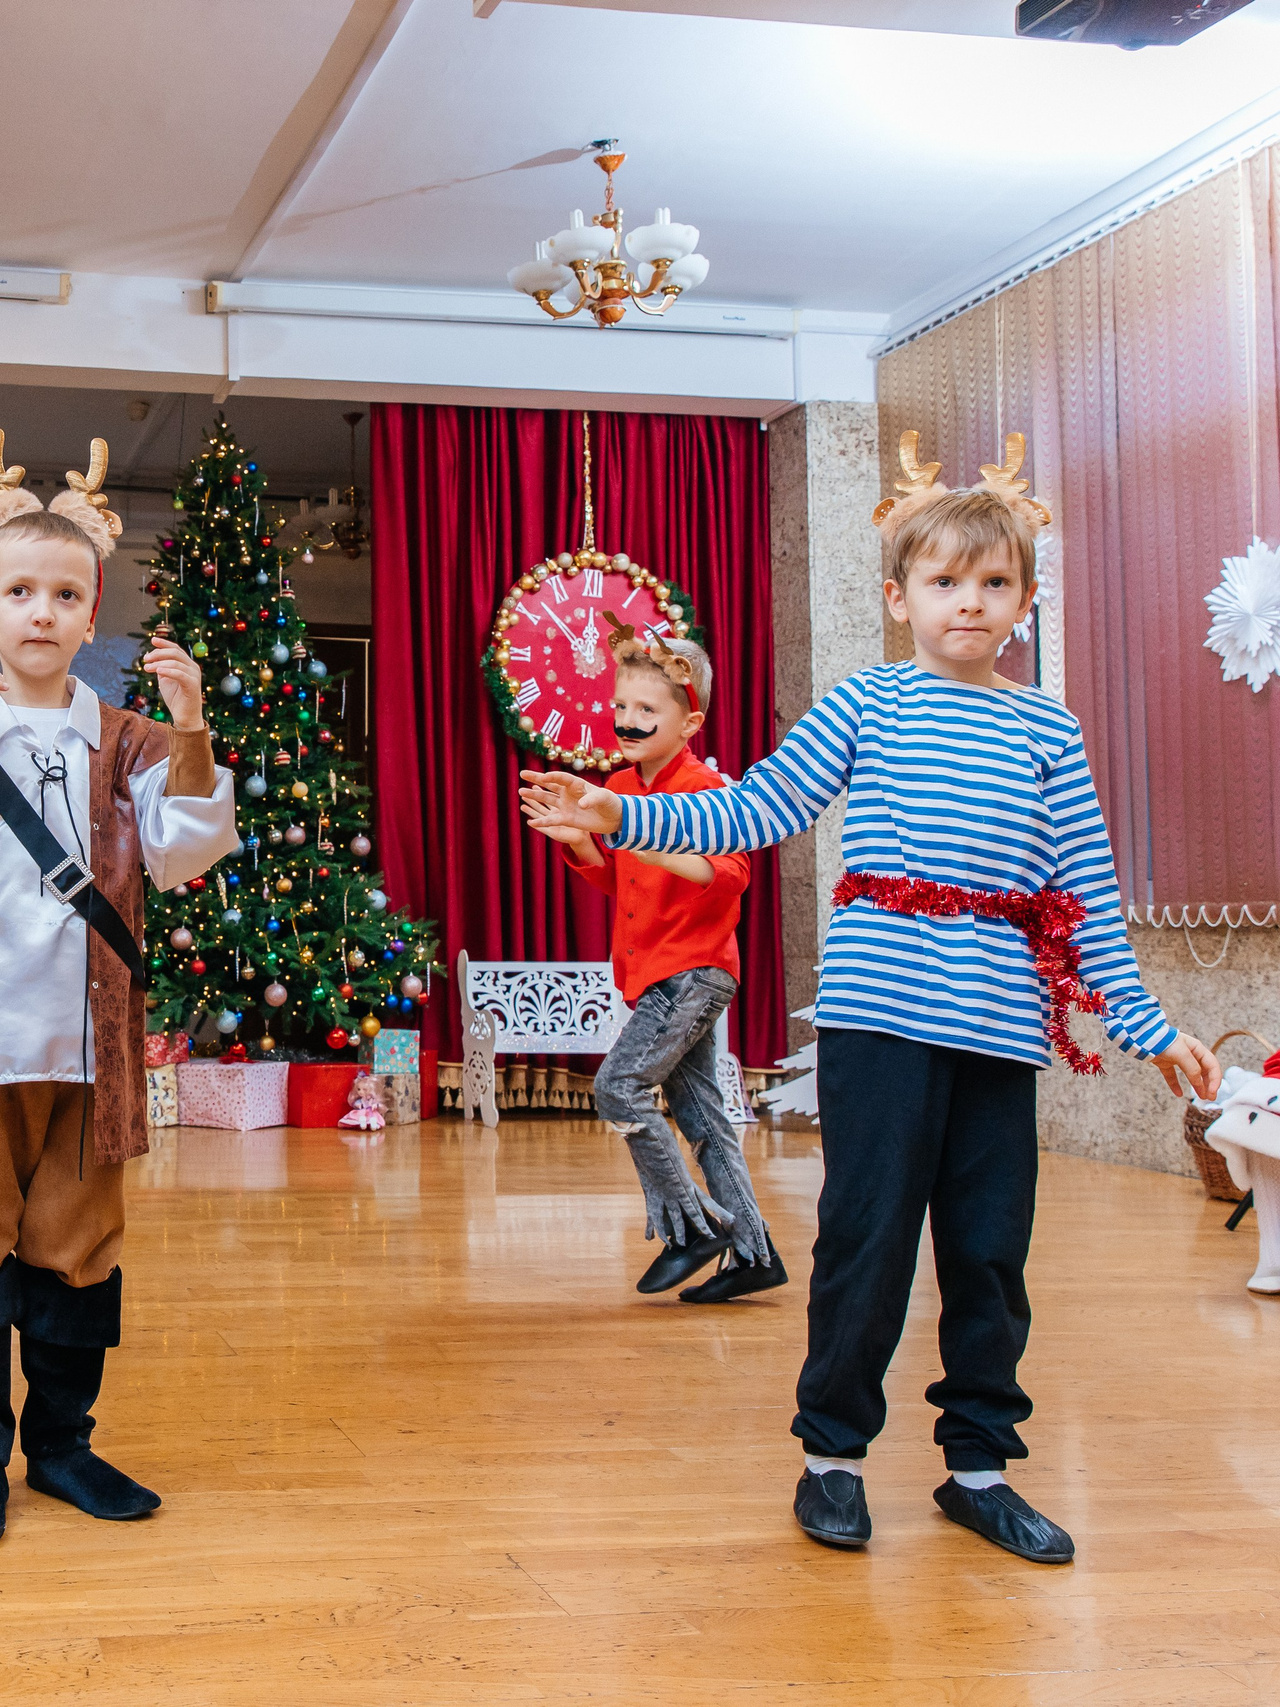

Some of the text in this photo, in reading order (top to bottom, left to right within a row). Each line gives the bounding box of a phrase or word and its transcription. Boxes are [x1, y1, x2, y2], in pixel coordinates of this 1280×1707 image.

[545, 574, 570, 605] XI
[582, 568, 604, 598] XII
[515, 601, 542, 626] X
[509, 645, 531, 663] IX
[516, 677, 541, 713] VIII
[540, 708, 565, 743] VII
